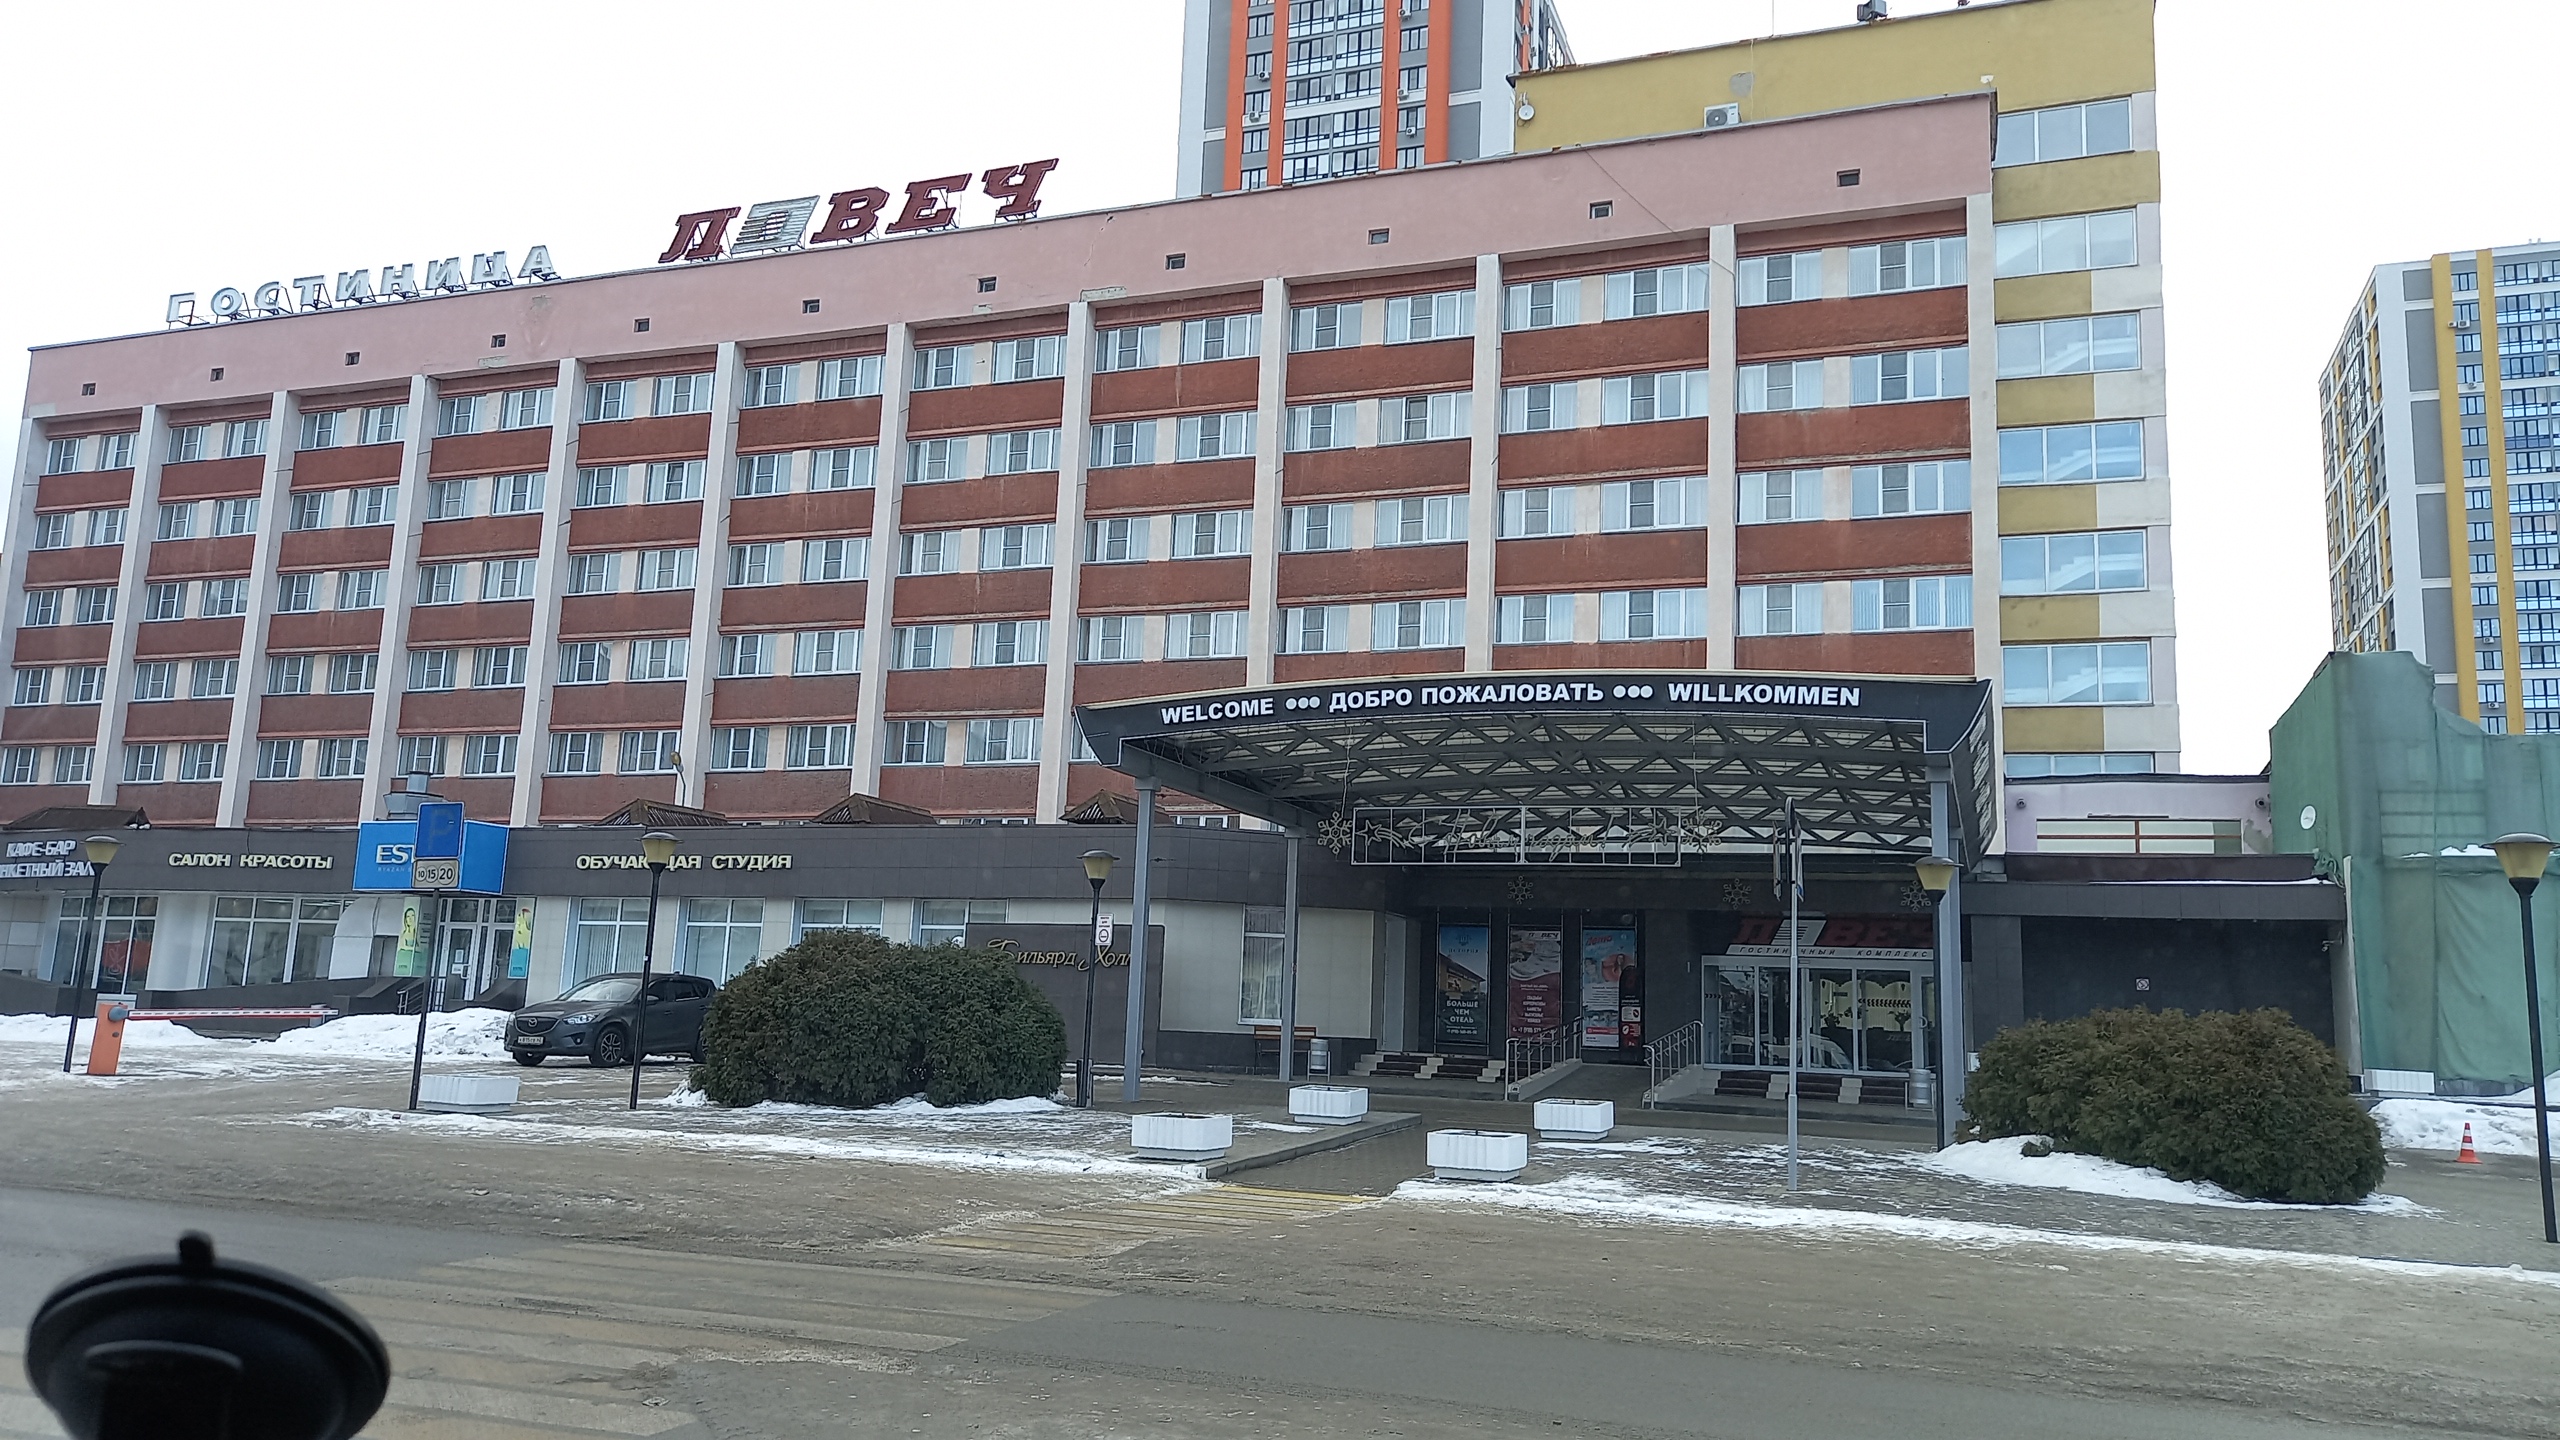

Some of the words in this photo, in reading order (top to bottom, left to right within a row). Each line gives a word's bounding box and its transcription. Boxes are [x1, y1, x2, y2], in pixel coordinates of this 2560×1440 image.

[166, 245, 556, 322] ГОСТИНИЦА
[1329, 688, 1413, 713] ДОБРО
[1421, 683, 1604, 706] ПОЖАЛОВАТЬ
[1668, 683, 1861, 707] WILLKOMMEN
[1161, 698, 1274, 724] WELCOME
[6, 840, 76, 857] КАФЕ-БАР
[64, 861, 95, 877] ЗАЛ
[168, 853, 232, 867] САЛОН
[239, 854, 334, 869] КРАСОТЫ
[711, 855, 793, 871] СТУДИЯ
[418, 870, 425, 878] 10
[428, 869, 436, 879] 15
[439, 868, 453, 880] 20
[1739, 947, 1836, 956] ГОСТИНЧНЫЙ
[1857, 950, 1928, 958] КОМПЛЕКС
[1447, 1000, 1479, 1008] БОЛЬШЕ
